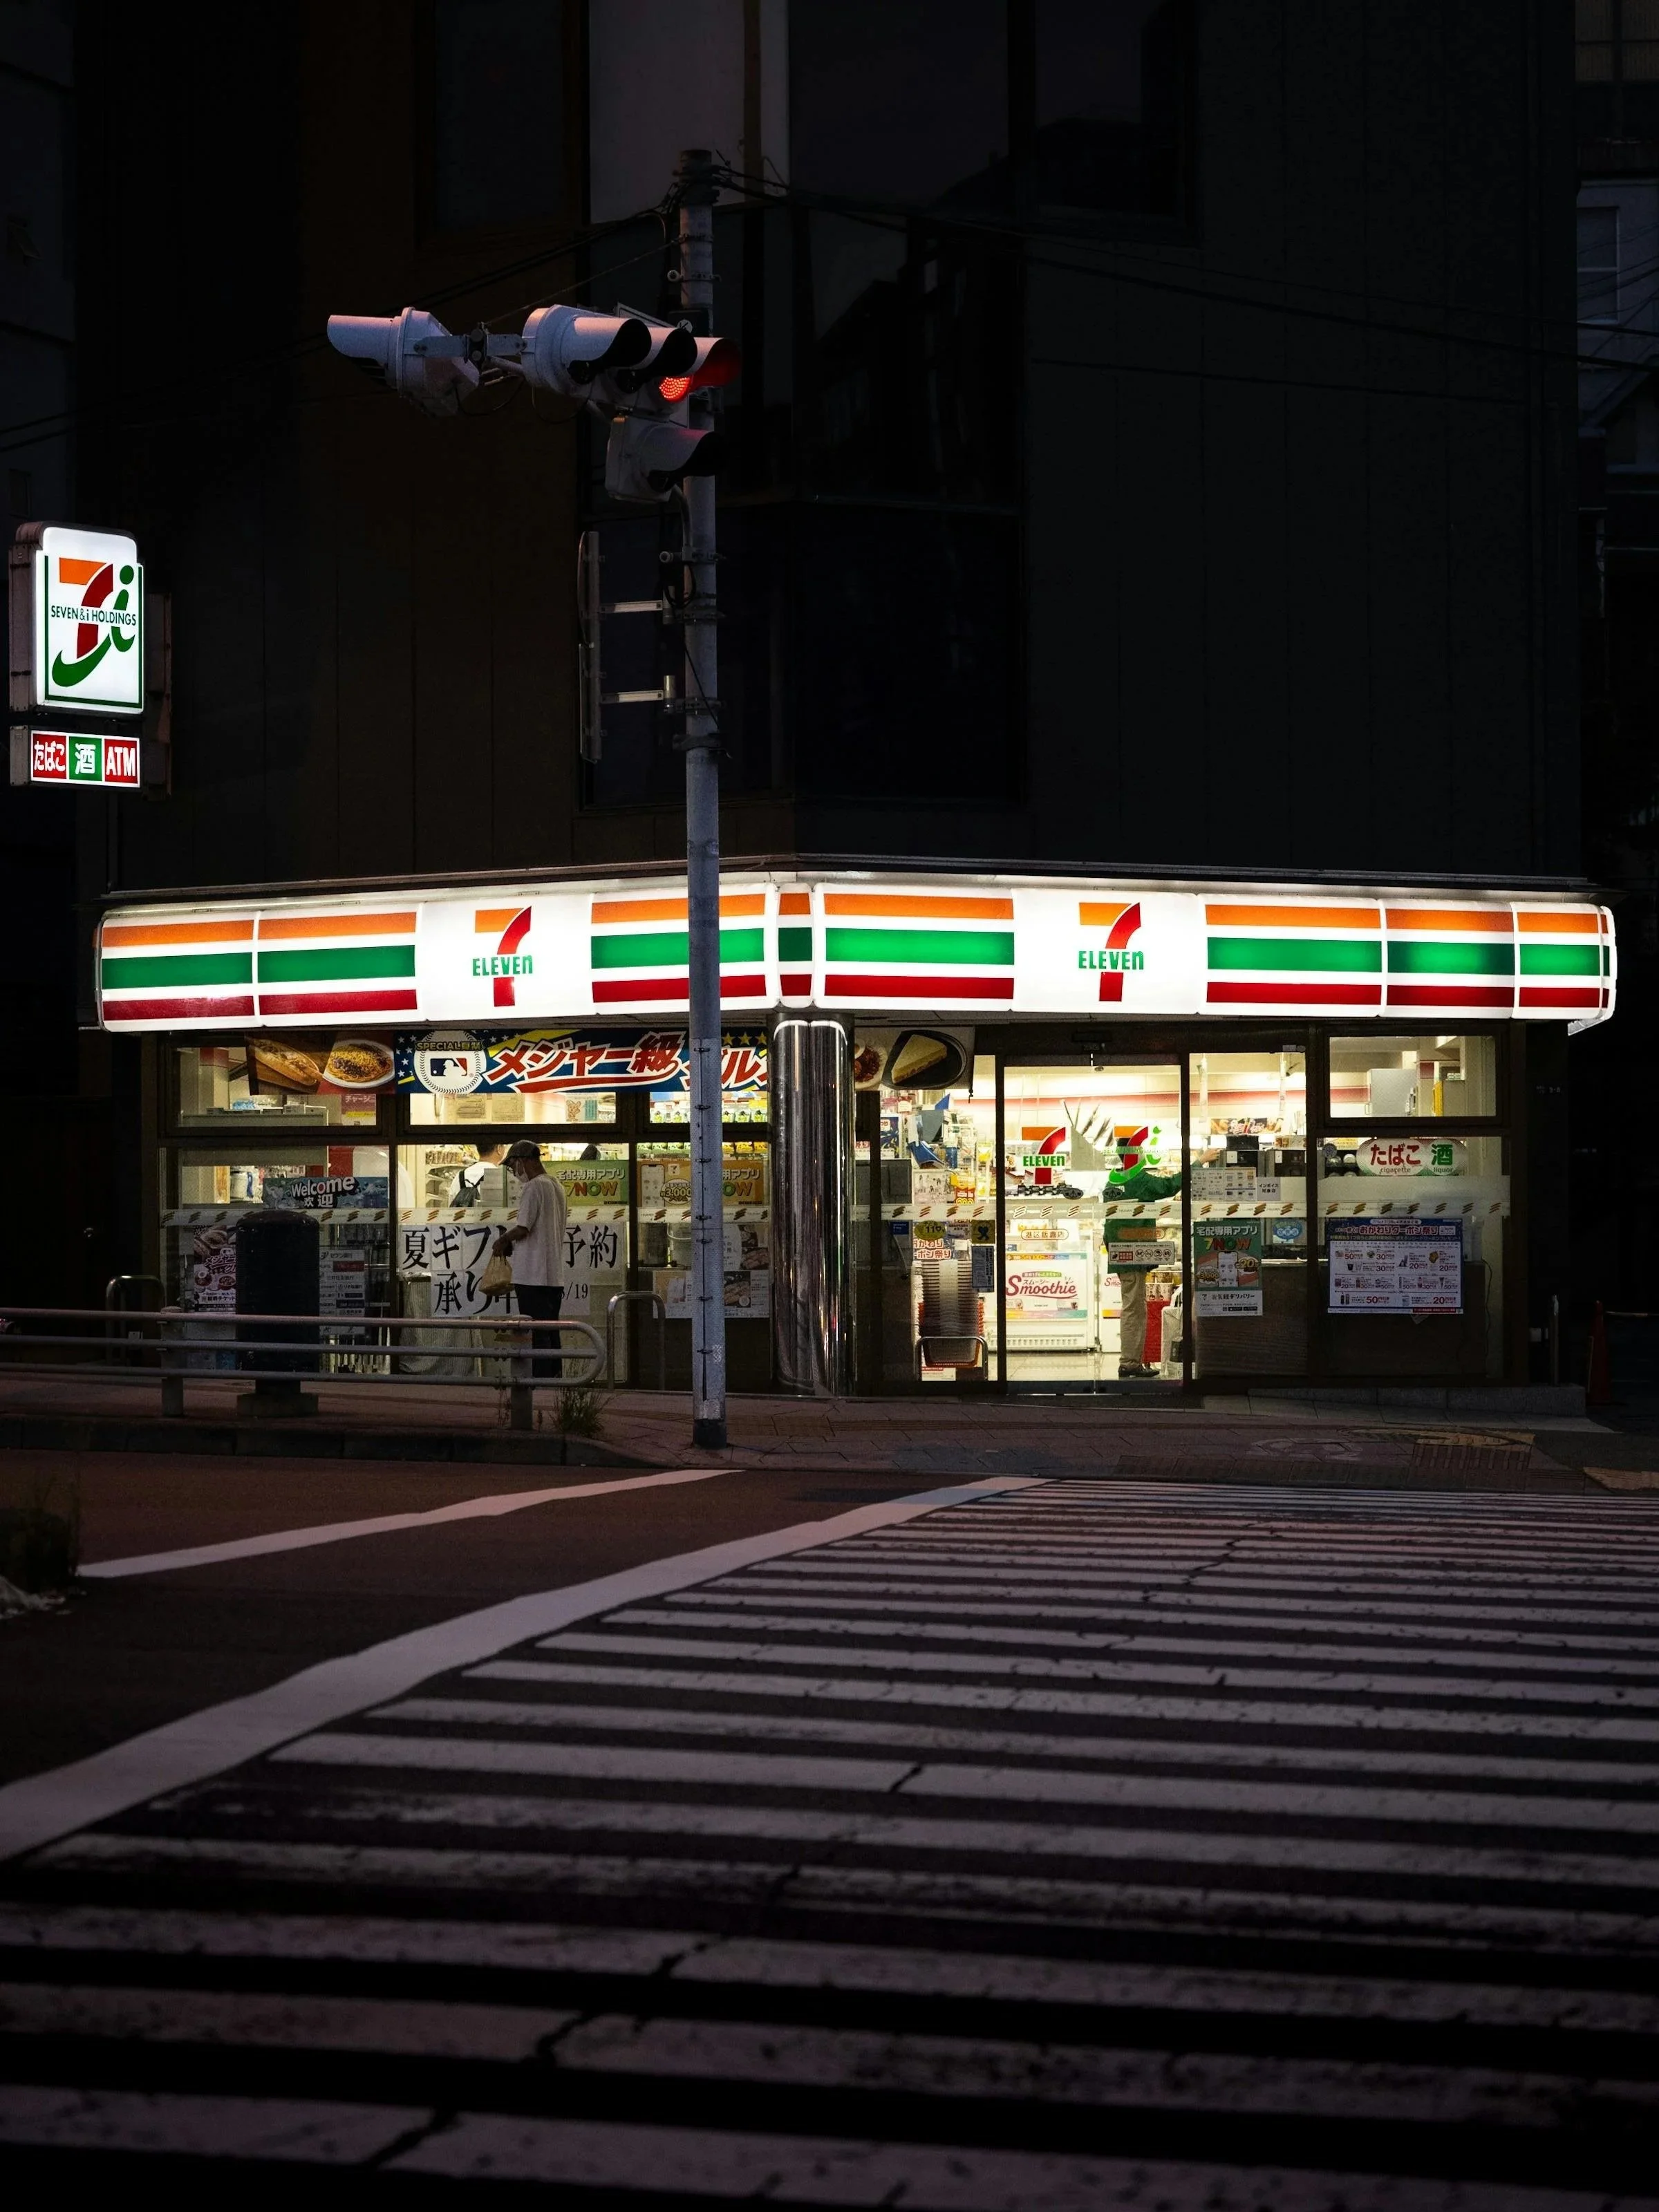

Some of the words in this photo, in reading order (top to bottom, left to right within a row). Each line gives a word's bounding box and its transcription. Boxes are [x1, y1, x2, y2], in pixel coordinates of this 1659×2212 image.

[92, 611, 137, 626] HOLDINGS
[34, 740, 66, 773] たばこ
[75, 742, 96, 775] 酒
[106, 747, 136, 777] ATM
[482, 1030, 768, 1091] メジャー級ル
[1371, 1143, 1421, 1165] たばこ
[1431, 1143, 1453, 1165] 酒
[555, 1168, 626, 1181] 宅配専用アプリ
[291, 1177, 355, 1197] Welcome
[304, 1194, 333, 1208] 欢迎
[1197, 1226, 1258, 1236] 宅配専用アプリ
[1360, 1225, 1438, 1235] おかわりクーポン祭り
[402, 1224, 619, 1271] 夏ギフ予約
[1204, 1237, 1251, 1250] 7NOW
[1006, 1275, 1076, 1296] Smoothie
